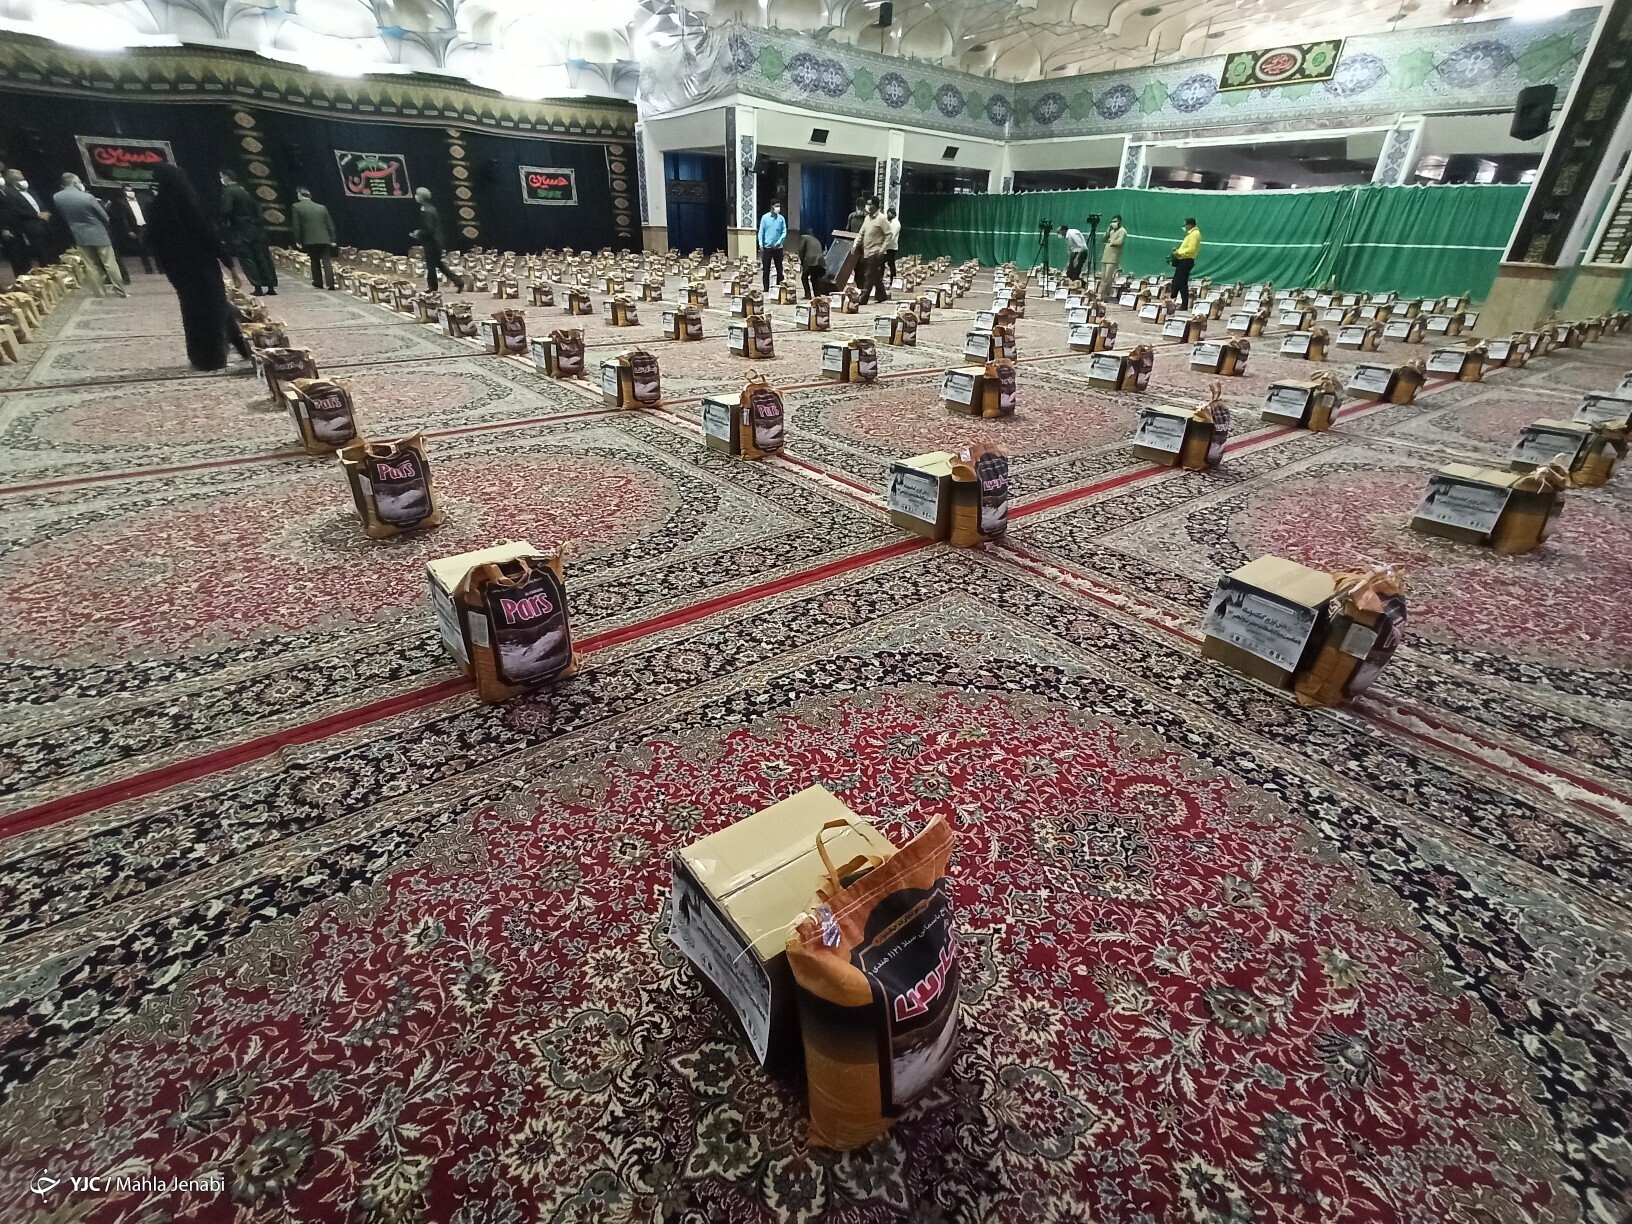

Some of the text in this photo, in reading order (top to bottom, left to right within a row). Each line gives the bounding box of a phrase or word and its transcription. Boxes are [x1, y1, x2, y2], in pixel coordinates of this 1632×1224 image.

[529, 174, 569, 188] حسین
[757, 404, 780, 418] Pars
[376, 462, 416, 481] Pars
[500, 592, 553, 625] Pars
